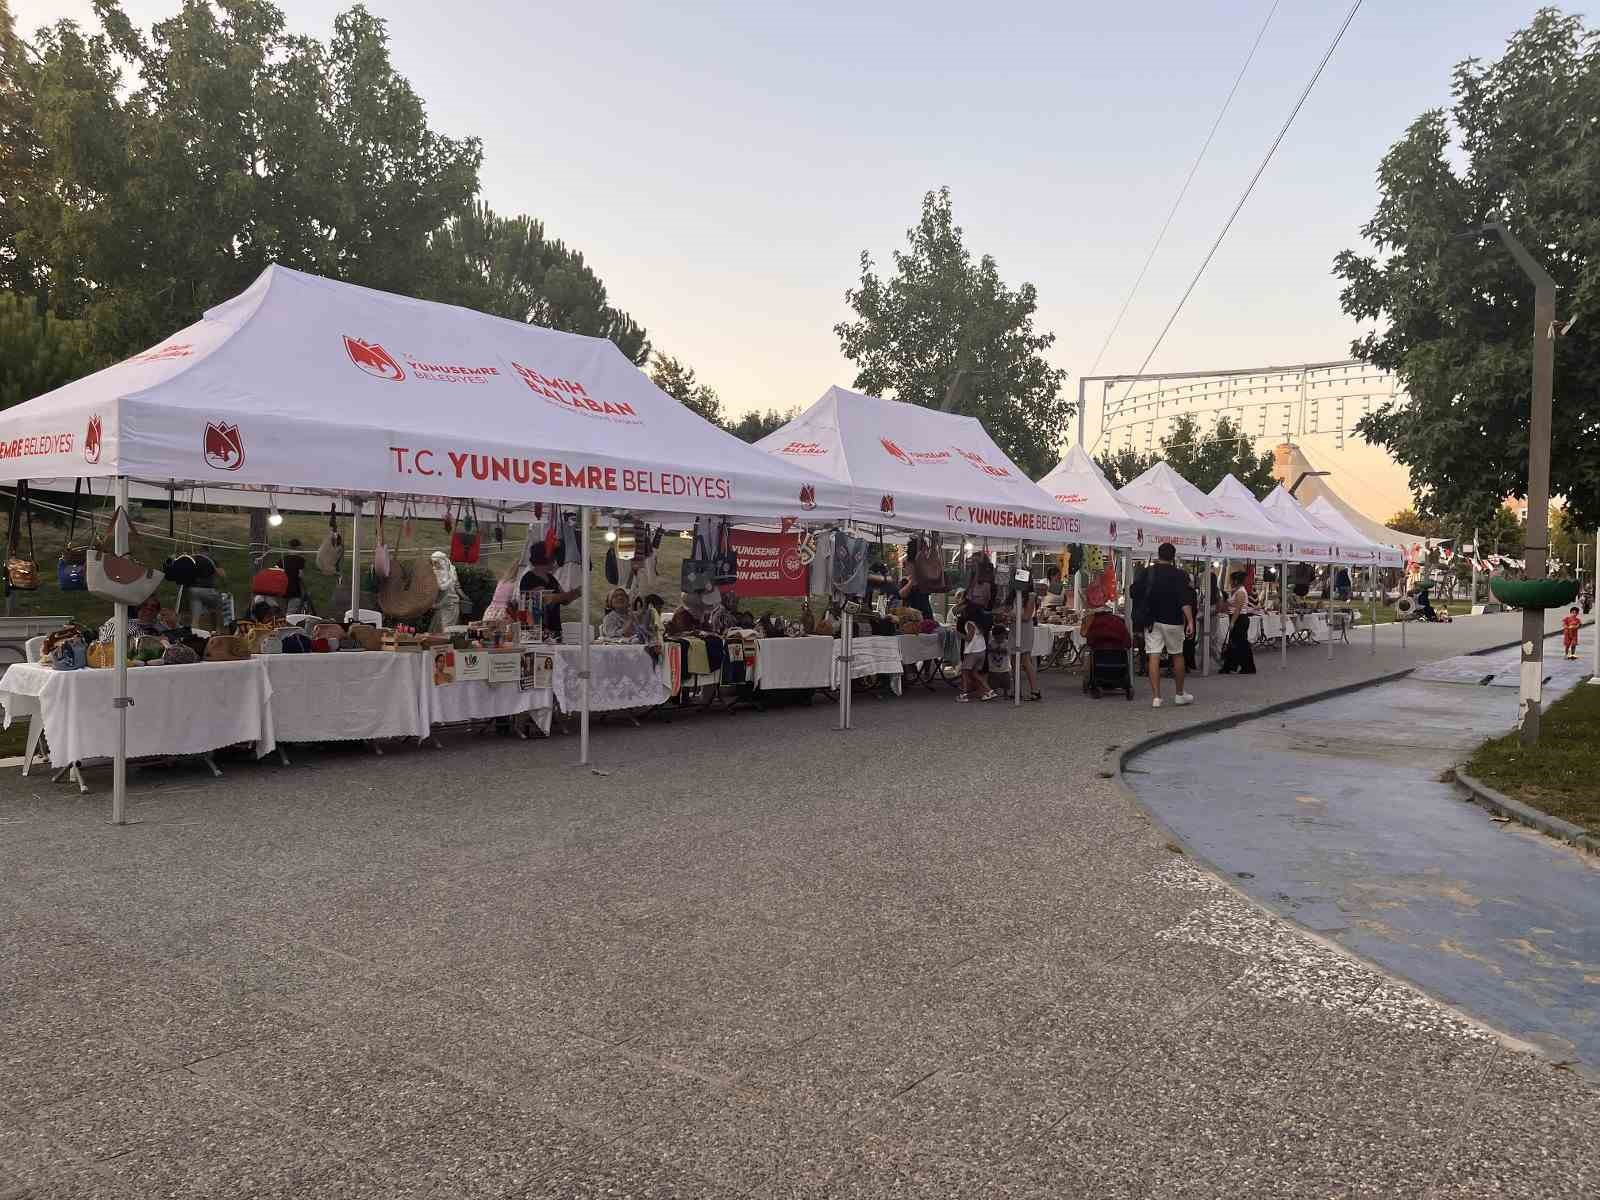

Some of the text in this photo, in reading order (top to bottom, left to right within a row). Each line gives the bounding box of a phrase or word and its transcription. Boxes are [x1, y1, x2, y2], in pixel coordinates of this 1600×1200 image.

[523, 377, 637, 417] BALABAN
[390, 447, 442, 476] T.C.
[448, 452, 617, 491] YUNUSEMRE
[968, 507, 1034, 529] YUNUSEMRE
